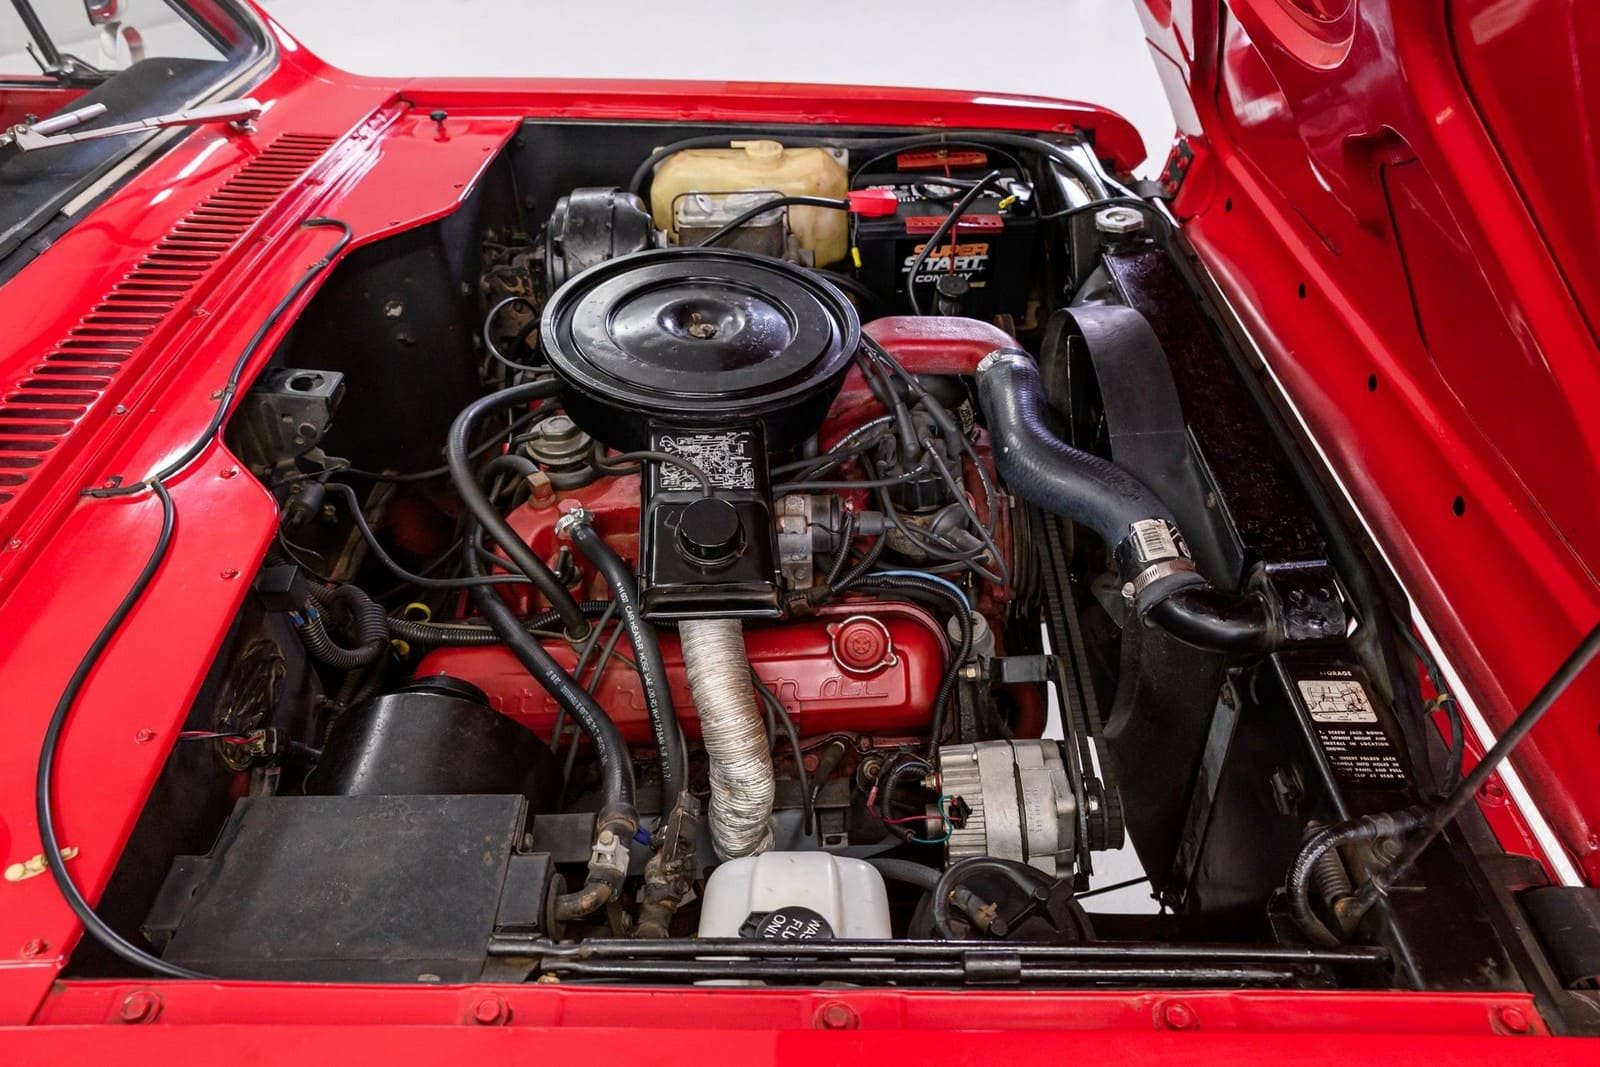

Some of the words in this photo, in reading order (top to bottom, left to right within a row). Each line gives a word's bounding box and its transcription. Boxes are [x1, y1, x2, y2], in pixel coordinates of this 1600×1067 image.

[913, 243, 989, 257] SUPER
[901, 255, 989, 272] START
[625, 605, 636, 621] CAR
[629, 621, 644, 651] HEATER
[640, 652, 650, 673] HOSE
